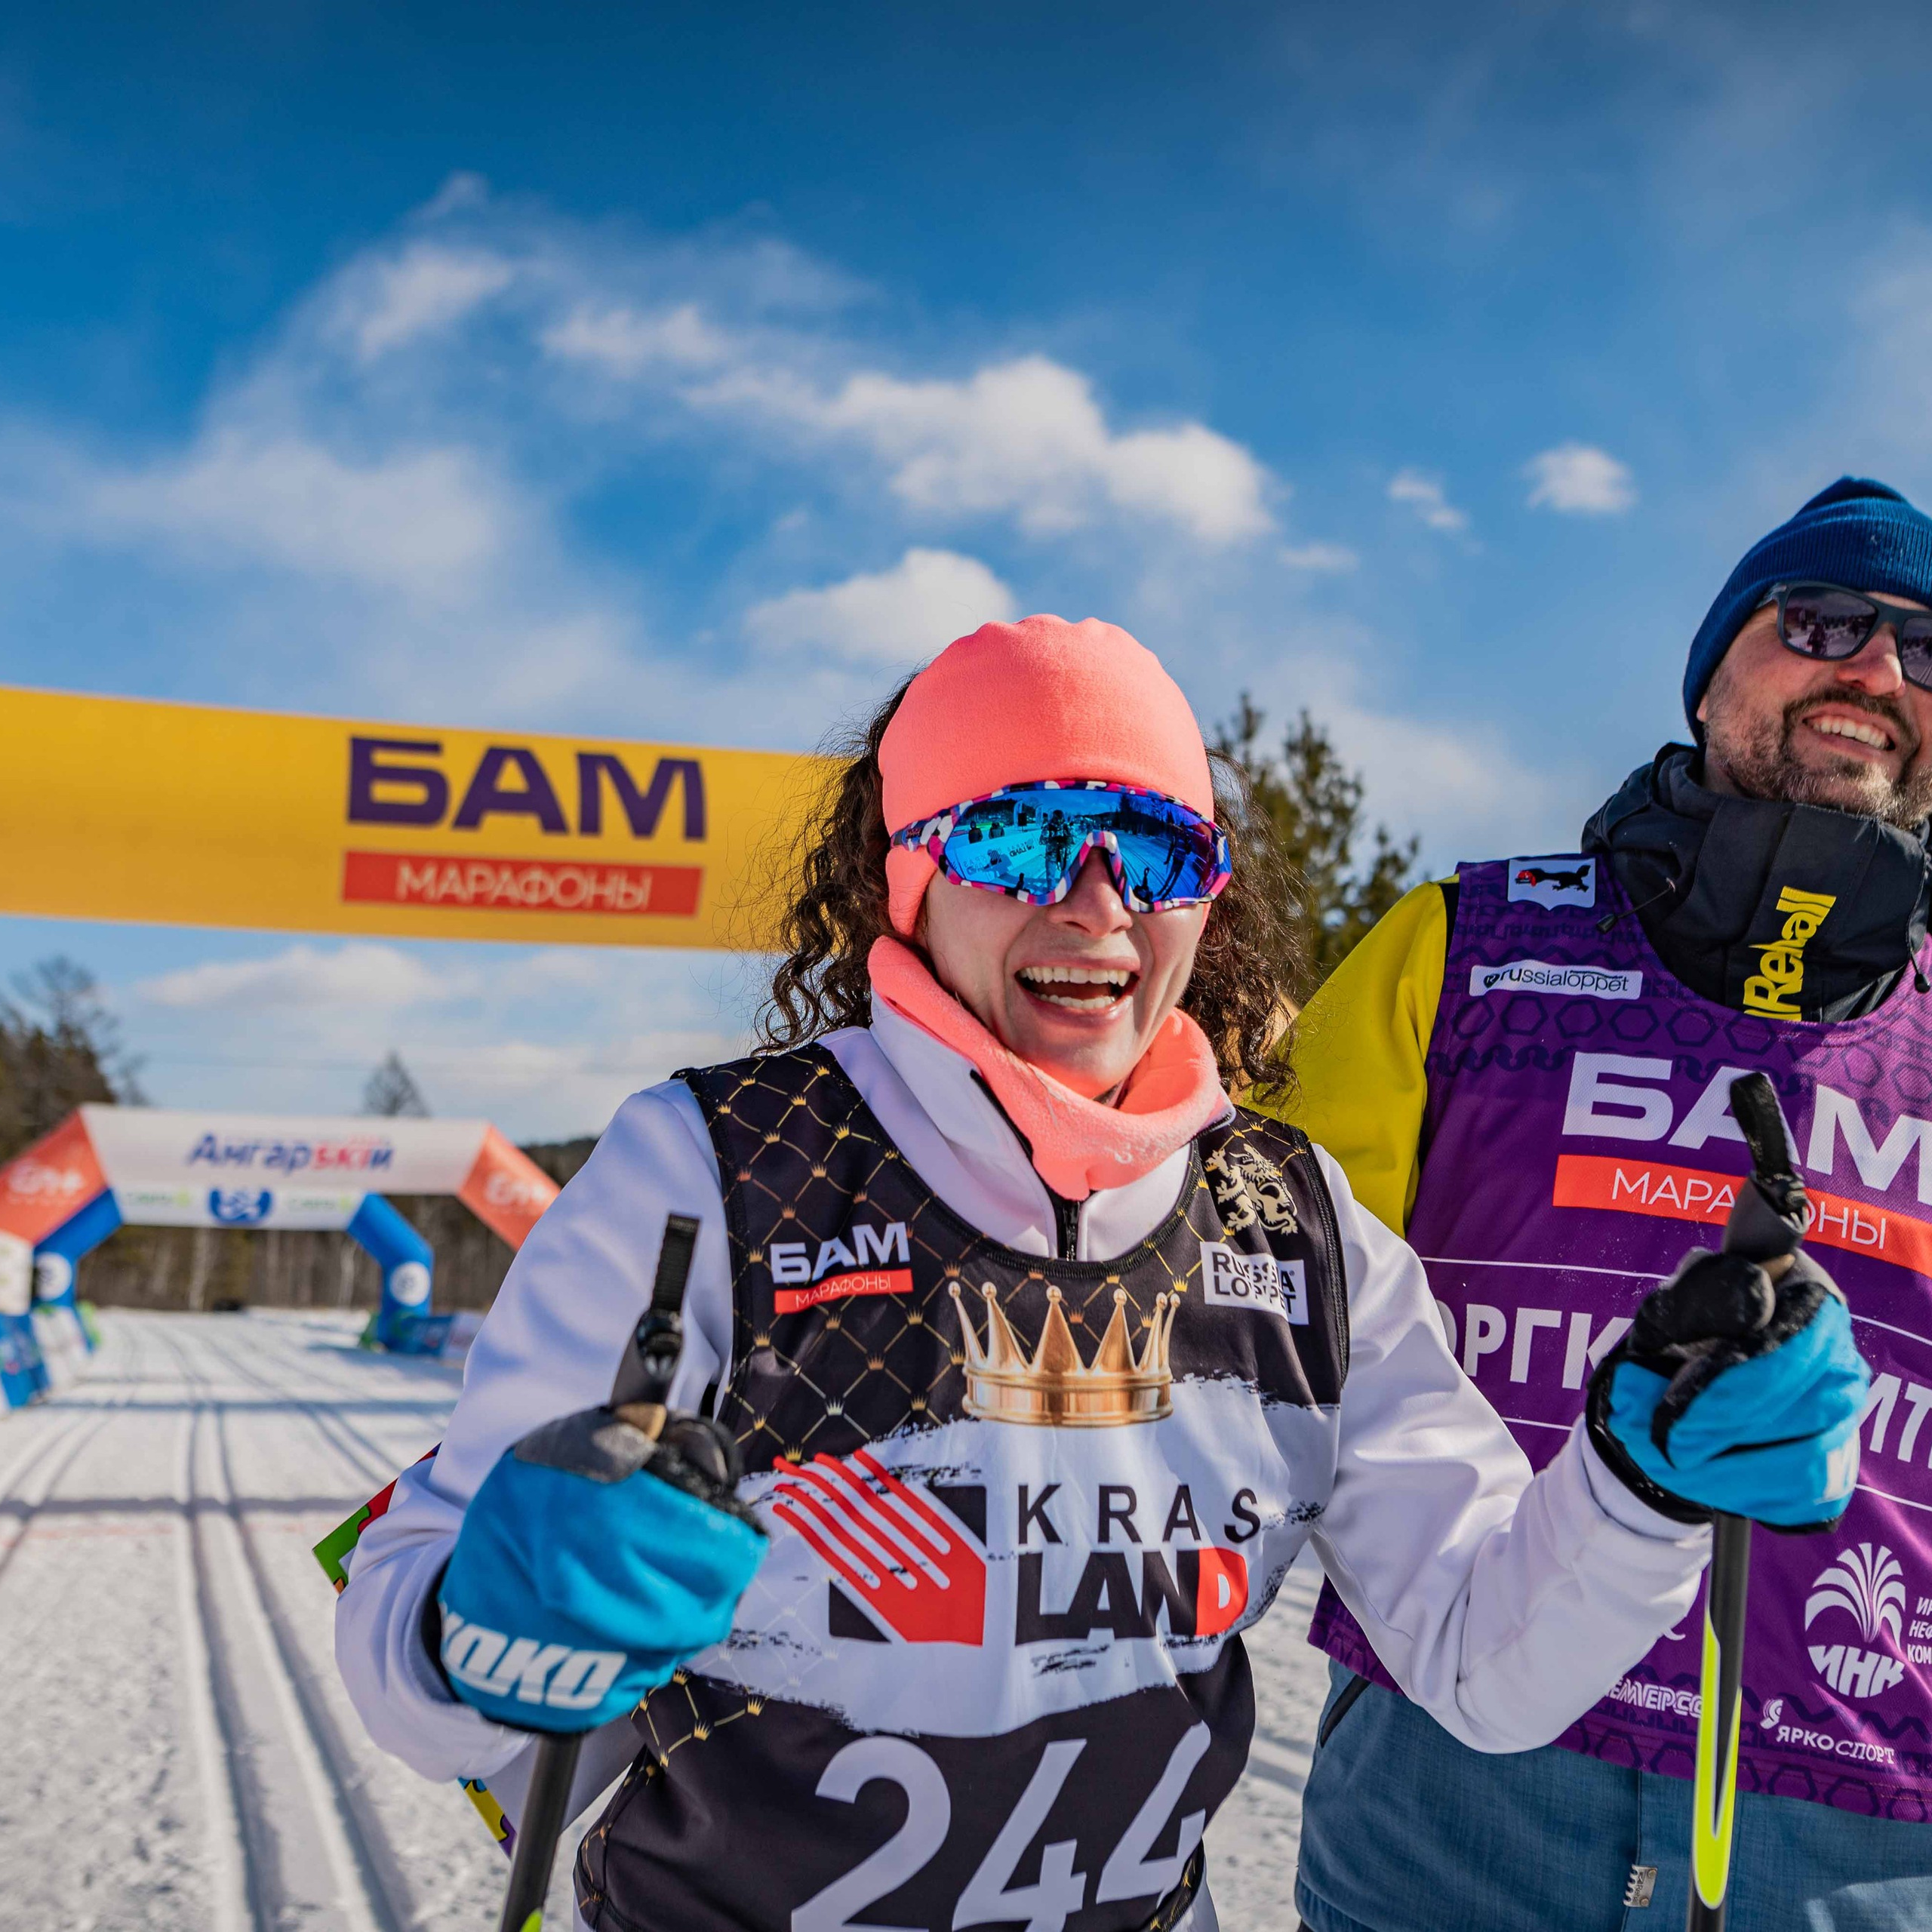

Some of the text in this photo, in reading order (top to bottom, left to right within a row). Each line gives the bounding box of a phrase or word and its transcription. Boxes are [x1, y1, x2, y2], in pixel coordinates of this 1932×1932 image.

[347, 735, 706, 842] БАМ
[396, 861, 654, 910] МАРАФОНЫ
[1500, 968, 1629, 992] russialoppet
[1743, 885, 1837, 1021] Rehall
[1562, 1051, 1932, 1206] БАМ
[771, 1221, 910, 1283] БАМ
[795, 1275, 891, 1309] МАРАФОНЫ
[1018, 1484, 1260, 1544] KRAS
[1015, 1547, 1249, 1647] LAND
[1807, 1644, 1906, 1698] ИНК
[1776, 1725, 1895, 1764] ЯРКОСПОРТ
[792, 1719, 1211, 1932] 244
